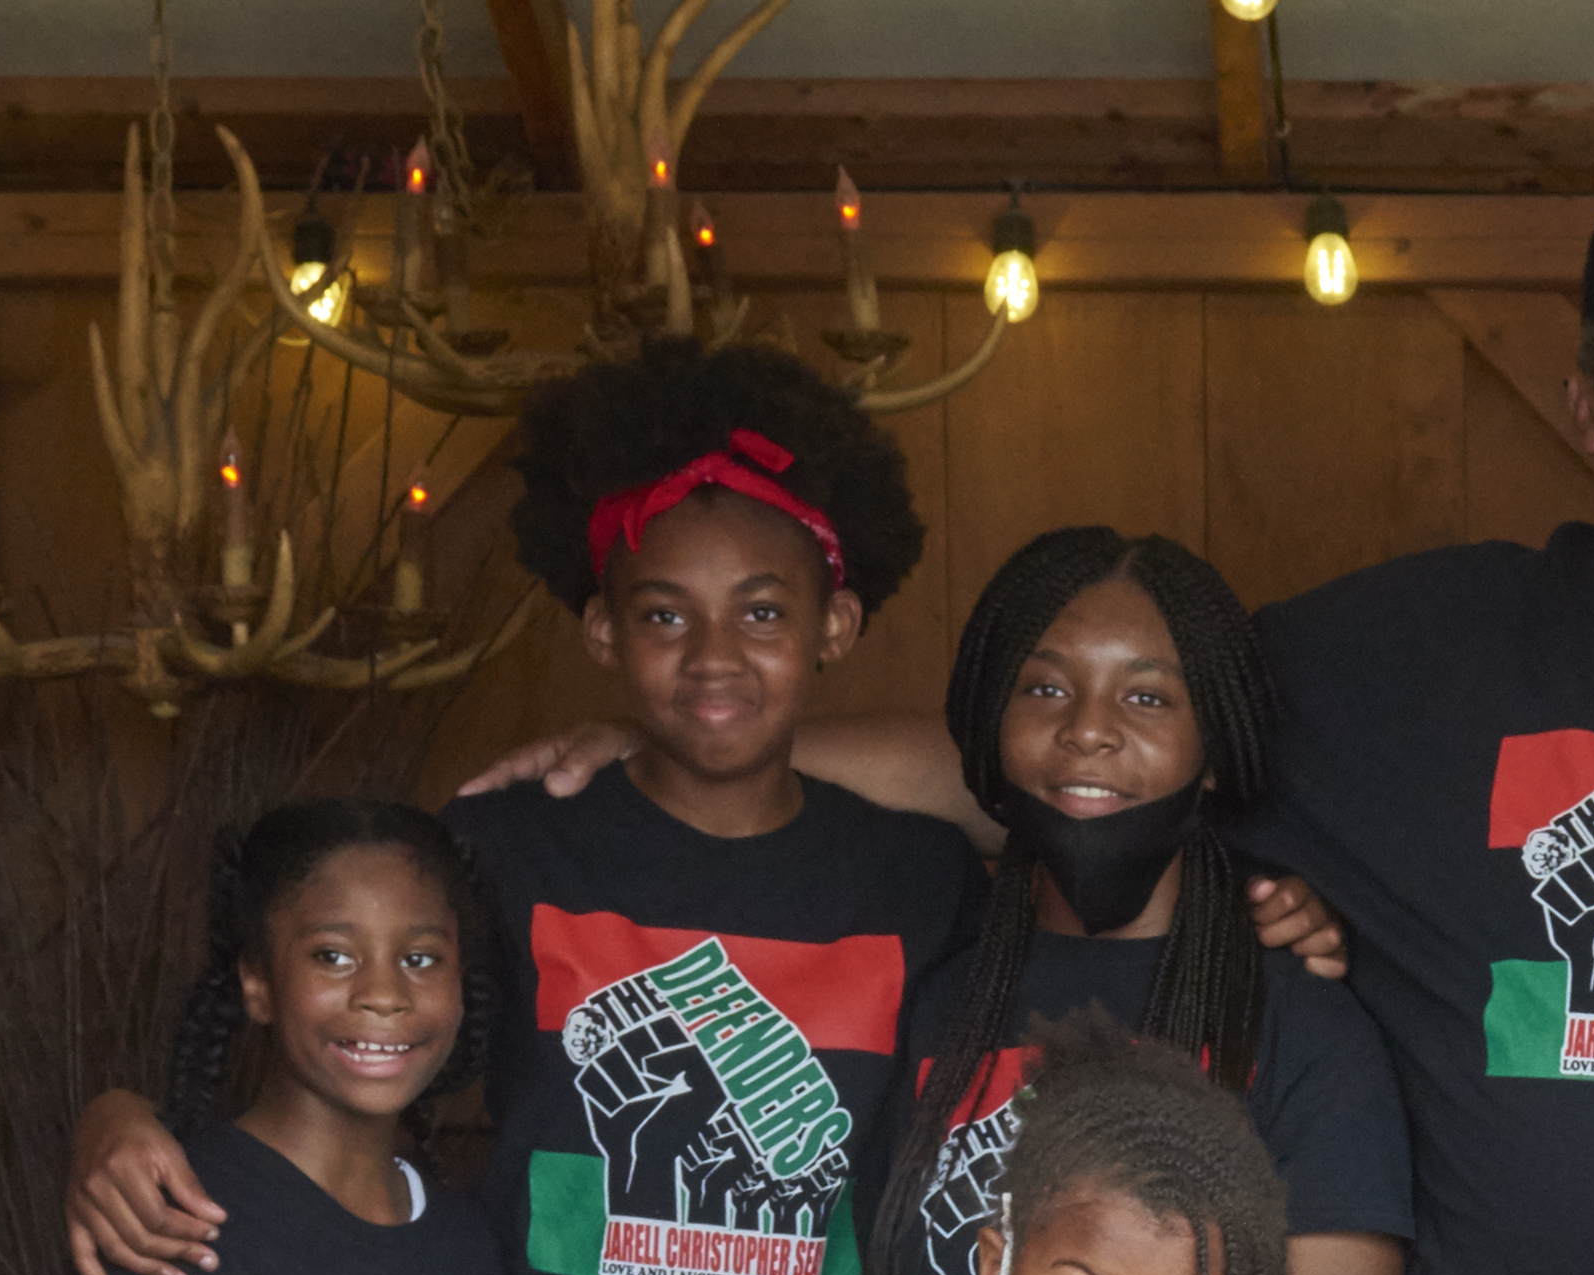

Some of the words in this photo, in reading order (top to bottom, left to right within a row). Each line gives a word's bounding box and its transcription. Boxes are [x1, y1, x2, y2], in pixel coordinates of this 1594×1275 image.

[588, 974, 670, 1034] THE
[648, 936, 853, 1180] DEFENDERS
[604, 1221, 662, 1266] JARELL
